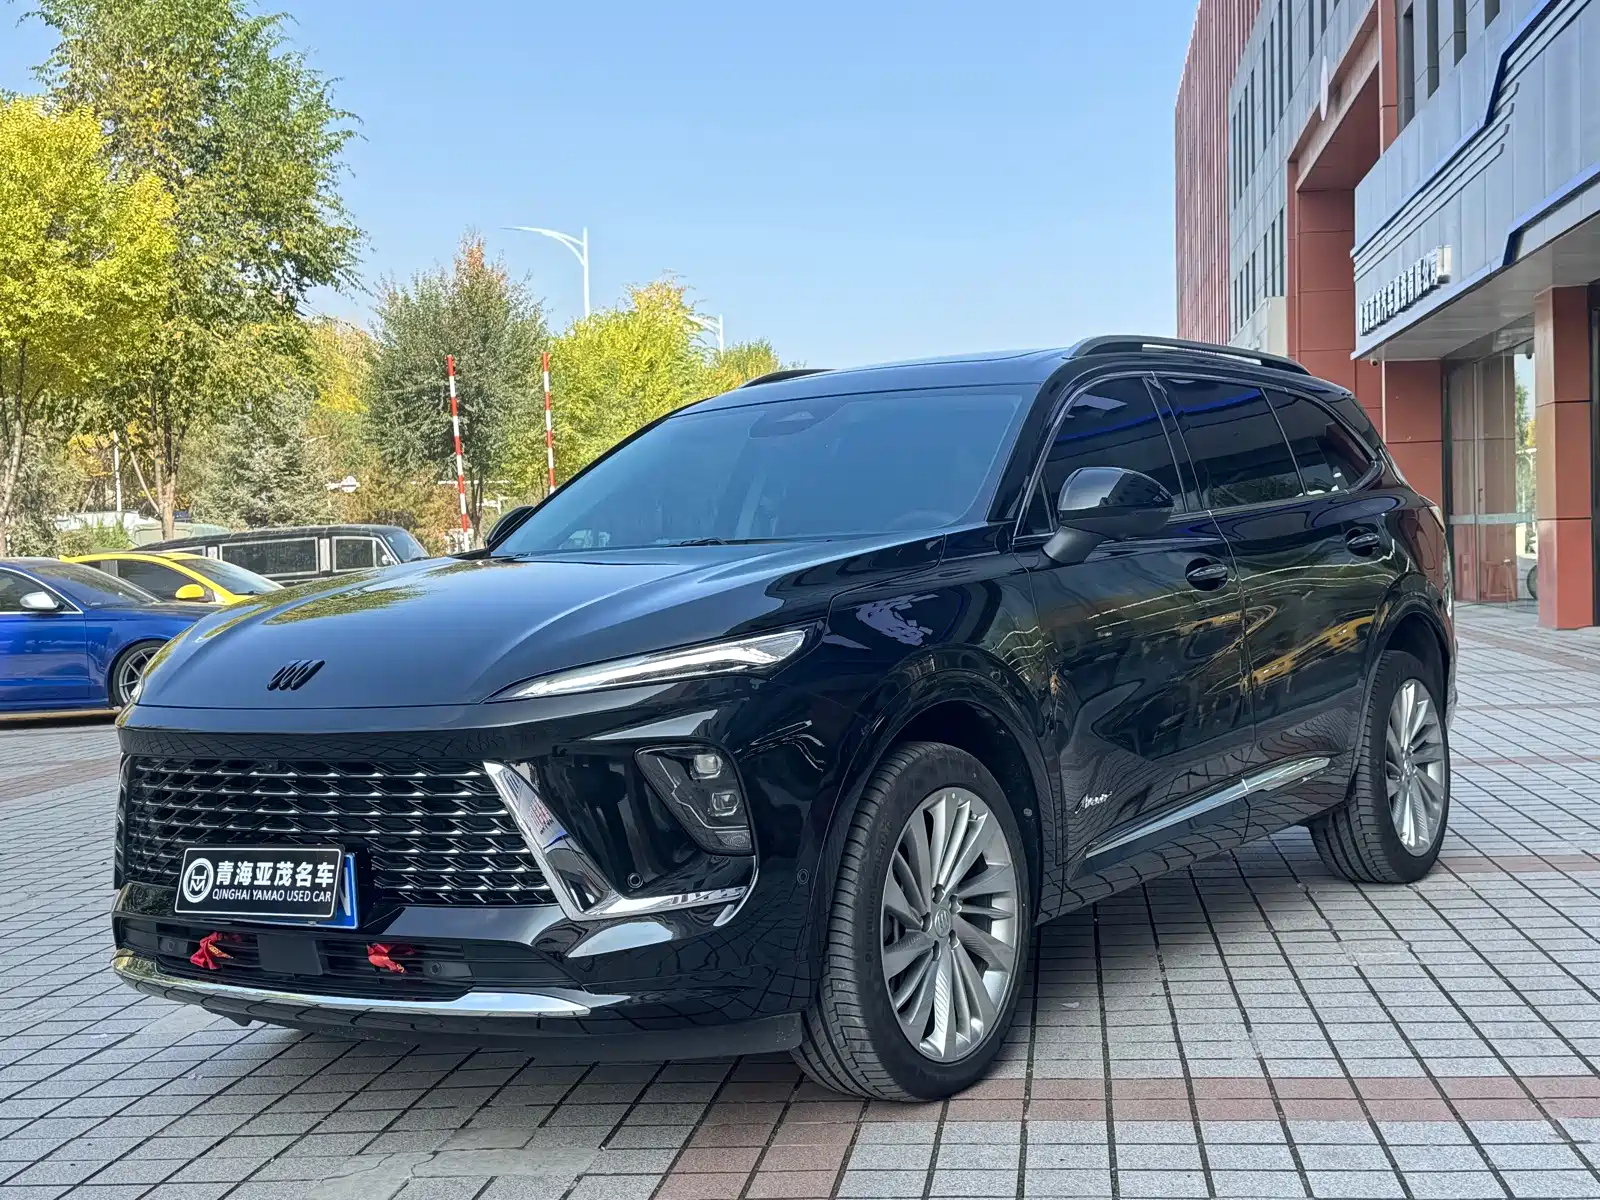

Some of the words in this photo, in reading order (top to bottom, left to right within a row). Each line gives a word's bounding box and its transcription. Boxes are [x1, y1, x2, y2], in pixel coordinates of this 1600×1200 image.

[216, 860, 335, 888] 青海亚茂名车
[212, 888, 251, 901] QINGHAI
[252, 889, 285, 901] YAMAO
[286, 890, 311, 902] USED
[312, 890, 332, 902] CAR
